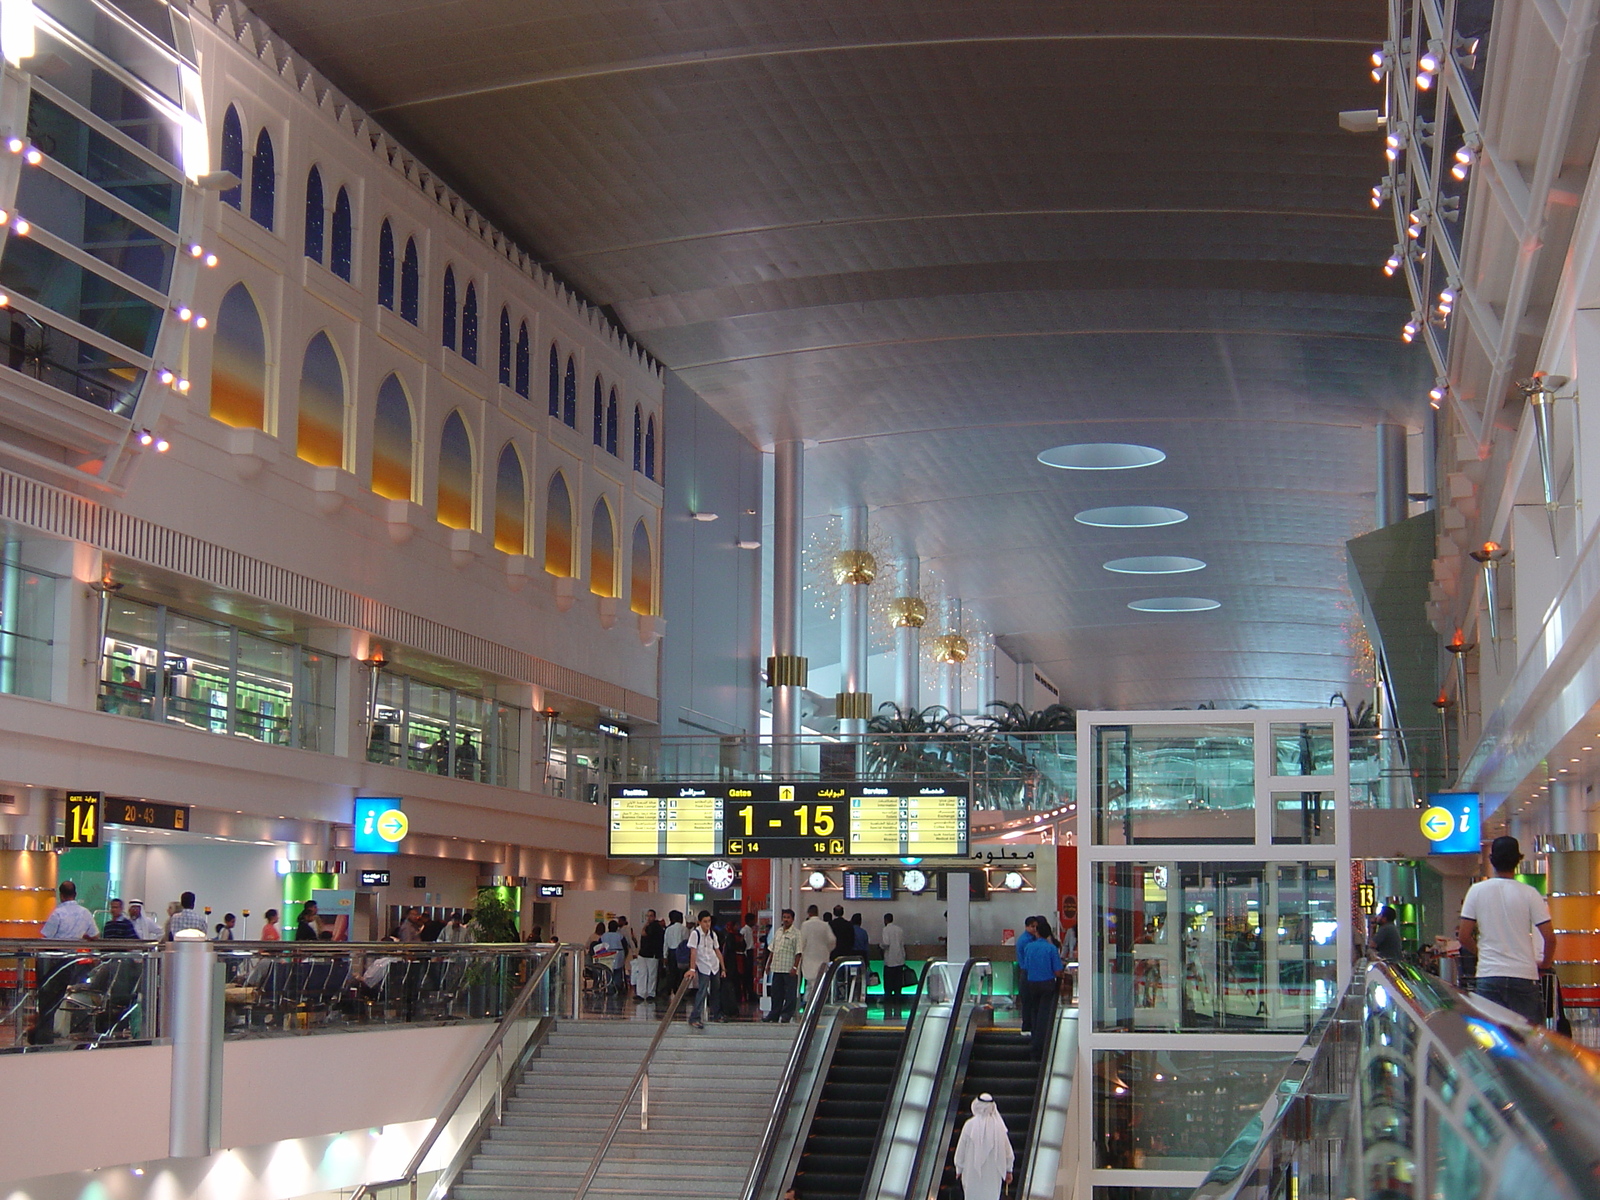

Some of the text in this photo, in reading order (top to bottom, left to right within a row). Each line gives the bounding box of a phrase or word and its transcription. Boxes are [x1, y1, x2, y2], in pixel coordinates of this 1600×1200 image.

[728, 788, 752, 798] Gates
[817, 788, 845, 798] البوابات
[125, 805, 136, 822] 20
[143, 807, 154, 823] 43
[70, 804, 95, 843] 14
[739, 805, 753, 836] 1
[793, 805, 835, 836] 15
[747, 842, 759, 852] 14
[813, 842, 826, 853] 15
[711, 861, 729, 871] COSTA
[1360, 888, 1374, 907] 13
